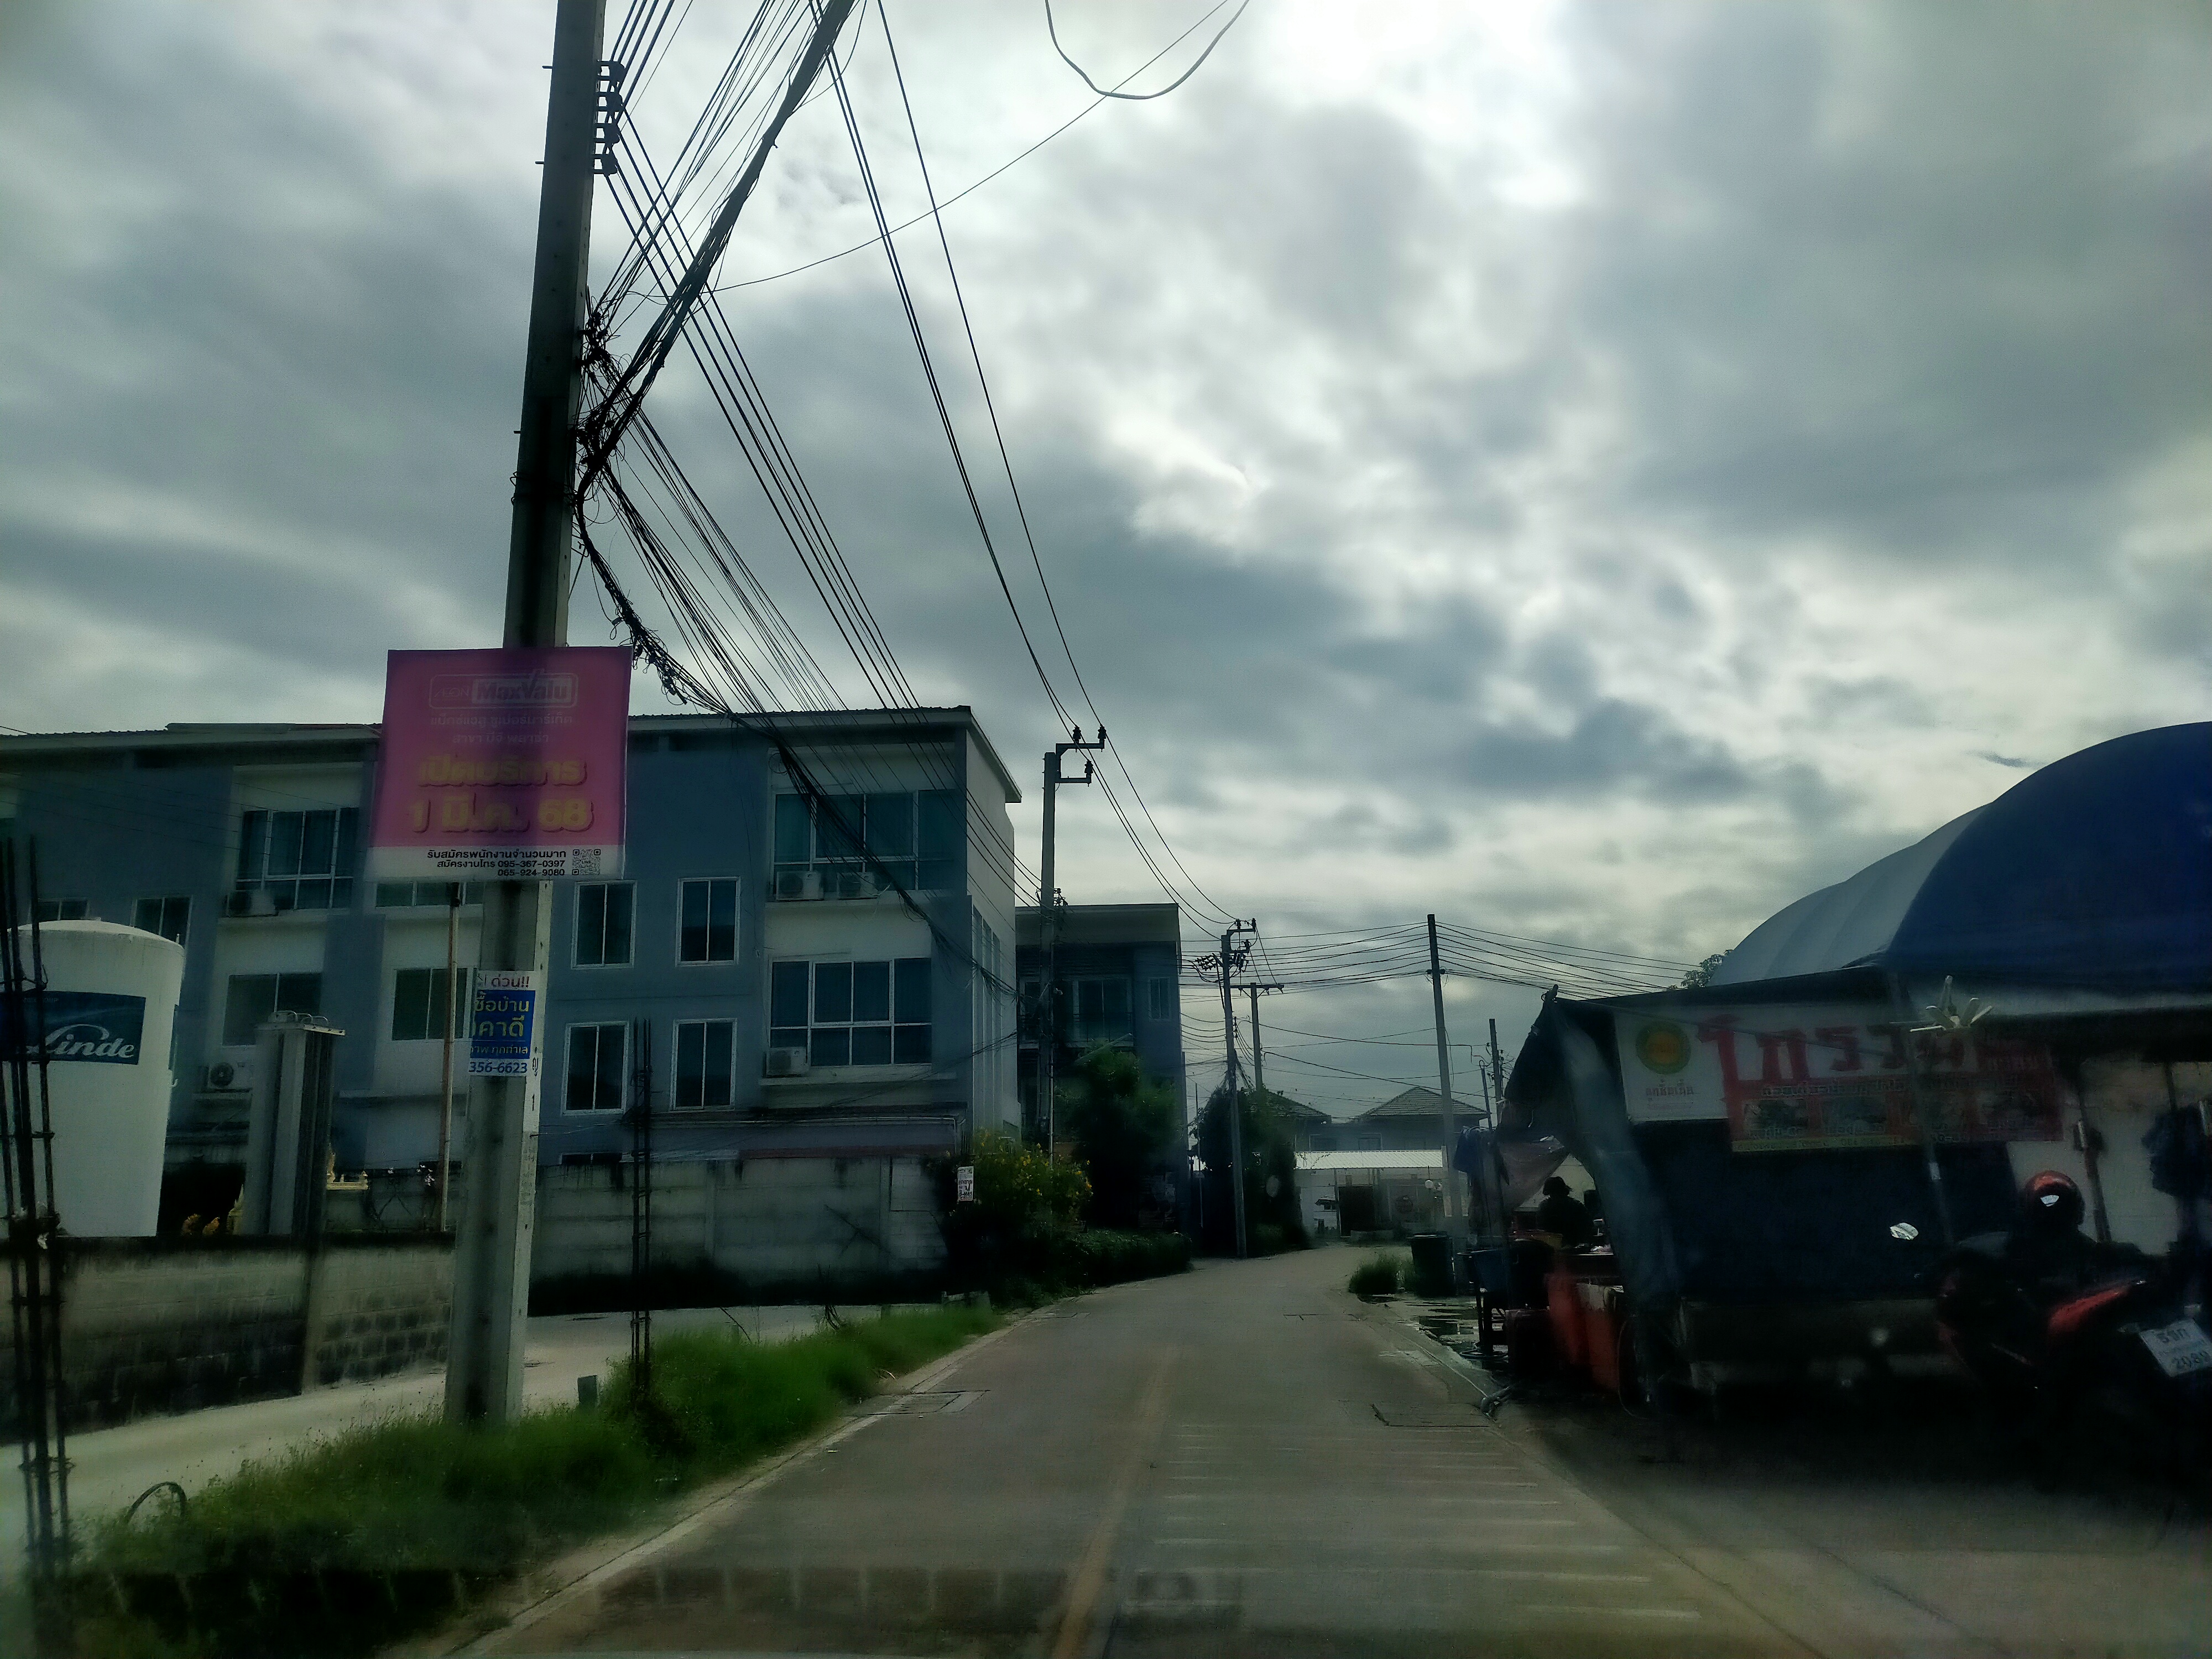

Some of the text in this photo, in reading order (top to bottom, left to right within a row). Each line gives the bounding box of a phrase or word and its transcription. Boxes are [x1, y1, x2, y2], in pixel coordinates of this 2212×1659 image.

[477, 670, 567, 700] MaxValu
[452, 734, 482, 744] สาขา
[418, 754, 585, 785] เปิดบริการ
[539, 799, 593, 832] 68
[427, 848, 566, 859] รับสมัครพนักงานจำนวนมาก
